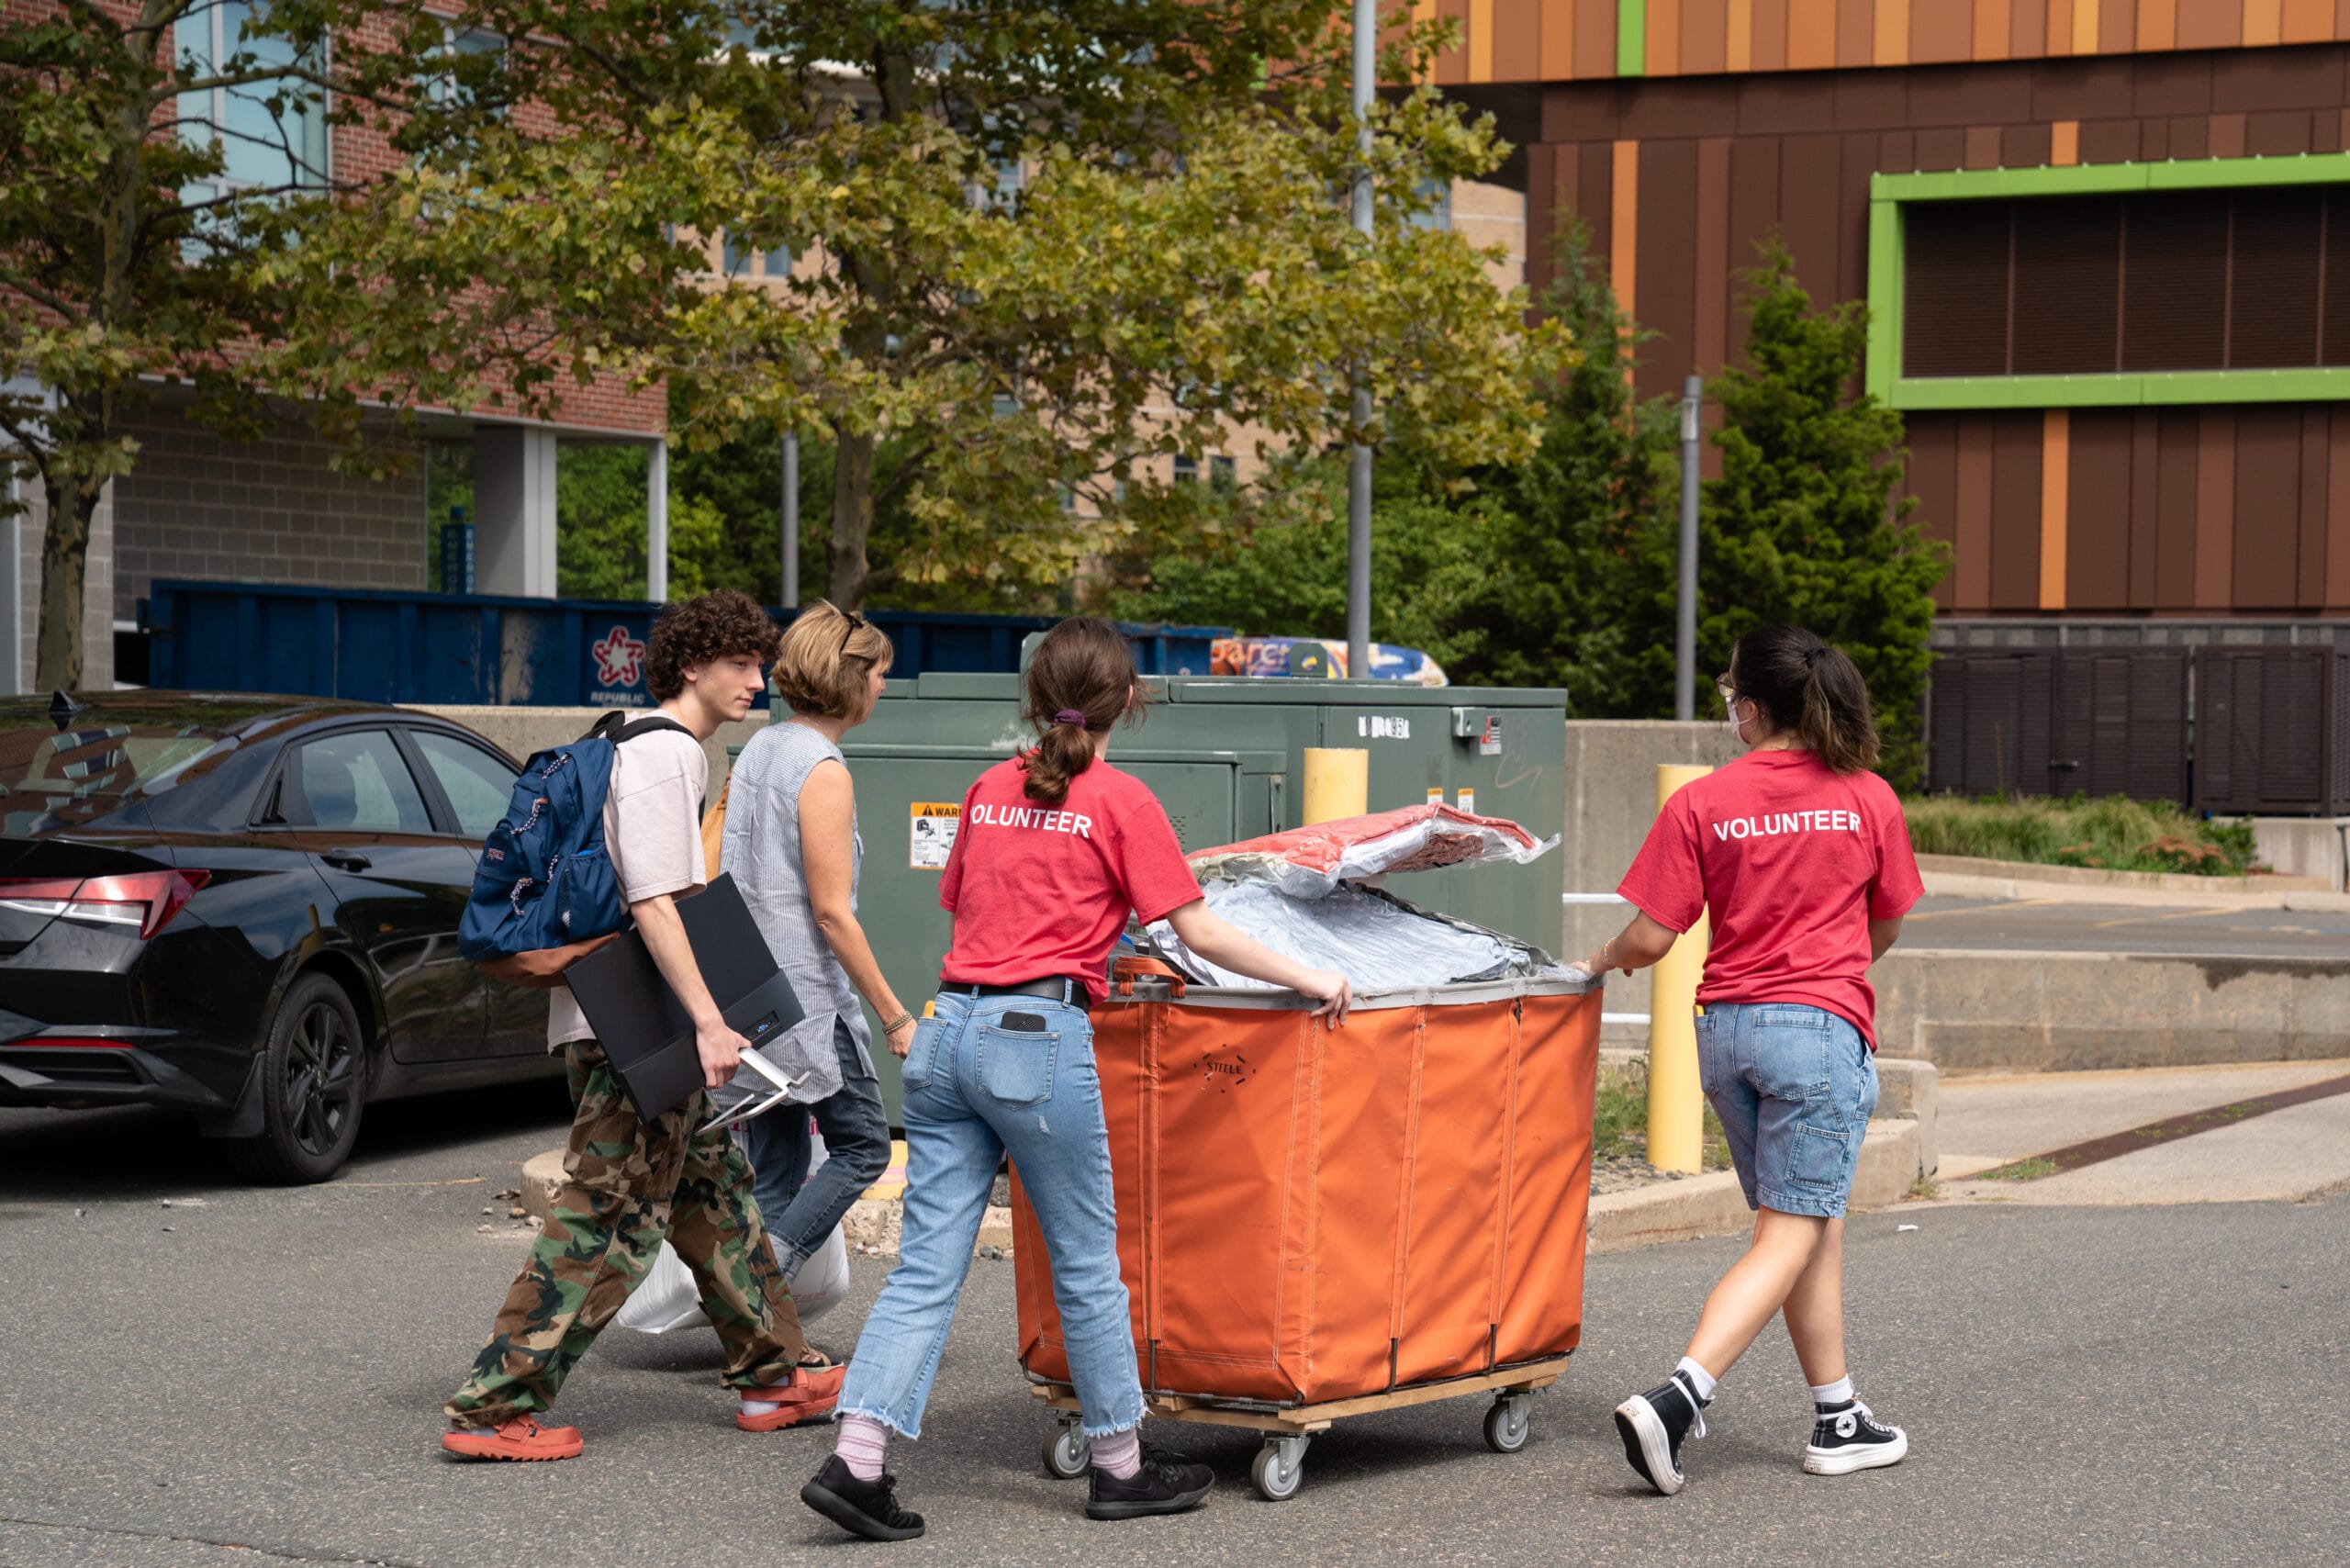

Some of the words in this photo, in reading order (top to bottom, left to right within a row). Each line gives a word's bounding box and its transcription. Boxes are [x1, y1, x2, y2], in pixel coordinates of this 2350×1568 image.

[590, 691, 645, 704] REPUBLIC
[970, 804, 1092, 838] OLUNTEER
[1713, 810, 1861, 841] VOLUNTEER
[1207, 1062, 1242, 1074] STEELE
